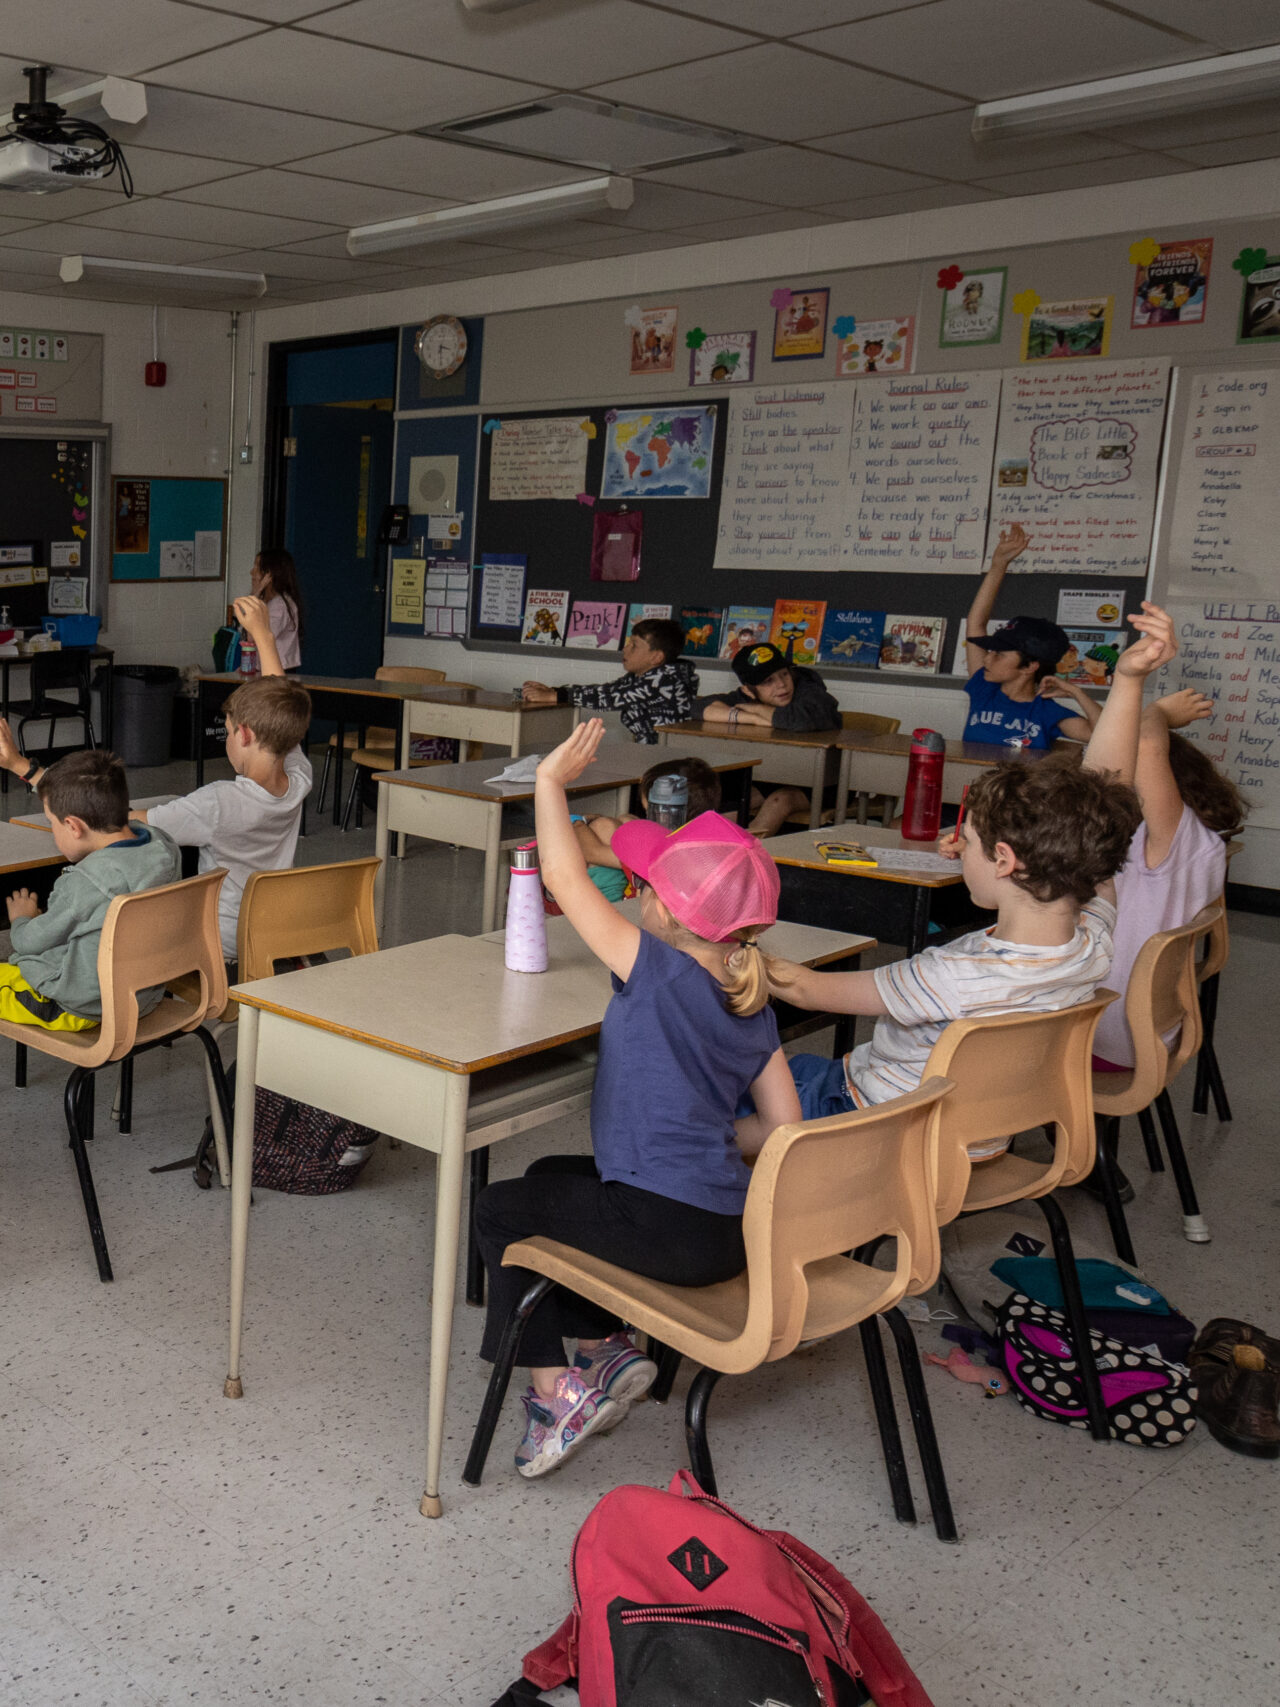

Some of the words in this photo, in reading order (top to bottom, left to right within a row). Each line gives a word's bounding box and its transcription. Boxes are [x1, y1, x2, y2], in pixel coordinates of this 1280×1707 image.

[1150, 266, 1195, 276] FOREVER
[1065, 374, 1088, 383] them
[1122, 370, 1146, 378] most
[887, 378, 928, 394] Journal
[936, 377, 970, 391] Rules
[783, 388, 826, 404] Listening
[1110, 398, 1129, 406] were
[742, 406, 761, 418] Still
[870, 400, 884, 412] We
[890, 398, 918, 412] work
[942, 402, 959, 410] our
[1214, 405, 1236, 417] sign
[870, 418, 885, 432] We
[891, 416, 920, 430] work
[743, 426, 764, 440] Eyes
[783, 424, 797, 436] the
[802, 423, 842, 440] speaker
[1040, 427, 1058, 442] The
[1064, 426, 1090, 442] BIG
[1096, 425, 1128, 441] Little
[774, 442, 800, 453] about
[808, 440, 834, 452] what
[868, 437, 884, 450] We
[890, 436, 922, 450] sound
[928, 434, 948, 448] out
[959, 432, 980, 446] the
[1038, 446, 1069, 461] Book
[1075, 446, 1090, 460] of
[1199, 447, 1234, 456] GROUP
[740, 461, 760, 473] they
[783, 462, 814, 474] saying
[865, 454, 899, 467] words
[736, 476, 747, 488] Be
[754, 476, 789, 488] curious
[795, 476, 804, 487] to
[812, 474, 840, 487] know
[866, 472, 880, 485] We
[886, 472, 914, 490] push
[920, 470, 978, 484] ourselves
[1041, 467, 1070, 487] Happy
[1076, 466, 1122, 480] Sadness
[1204, 468, 1242, 480] Megan
[1200, 482, 1242, 490] Annabella
[735, 496, 756, 504] more
[761, 493, 788, 505] about
[796, 492, 825, 505] what
[861, 490, 908, 503] because
[916, 493, 930, 502] we
[939, 488, 971, 502] want
[1046, 492, 1064, 504] just
[1069, 492, 1082, 500] for
[1203, 496, 1226, 506] Koby
[732, 510, 752, 523] they
[758, 512, 772, 521] are
[778, 510, 816, 526] sharing
[858, 508, 867, 520] to
[872, 508, 885, 520] be
[890, 508, 924, 525] ready
[931, 508, 949, 521] for
[1197, 510, 1227, 518] Claire
[1086, 518, 1110, 526] filled
[1116, 518, 1137, 526] with
[1198, 524, 1220, 532] Ian
[734, 526, 754, 539] Stop
[758, 526, 796, 541] yourself
[805, 526, 832, 538] from
[858, 525, 872, 539] We
[882, 530, 901, 540] can
[908, 526, 922, 540] do
[929, 524, 958, 540] this!
[1056, 532, 1081, 540] heard
[1087, 532, 1104, 540] but
[1194, 538, 1218, 548] Henry
[728, 545, 762, 558] sharing
[766, 544, 792, 554] about
[852, 544, 904, 557] Remember
[910, 544, 920, 557] to
[926, 544, 947, 564] skip
[1191, 551, 1224, 562] Sophia
[1086, 557, 1117, 569] George
[528, 597, 564, 606] SCHOOL
[572, 606, 622, 631] Pink!
[835, 612, 872, 624] Stellaluna
[890, 624, 933, 638] GRYPHON
[1180, 624, 1216, 640] Claire
[1221, 626, 1240, 640] and
[1247, 626, 1274, 642] Zoe
[1180, 643, 1220, 662] Jayden
[1224, 648, 1245, 661] and
[1181, 664, 1222, 680] Kamelia
[1230, 668, 1250, 682] and
[1228, 689, 1249, 703] and
[1224, 709, 1246, 722] and
[1004, 718, 1041, 738] JAYS
[1208, 728, 1229, 743] and
[1239, 730, 1274, 752] Henry
[1235, 770, 1264, 787] Ian
